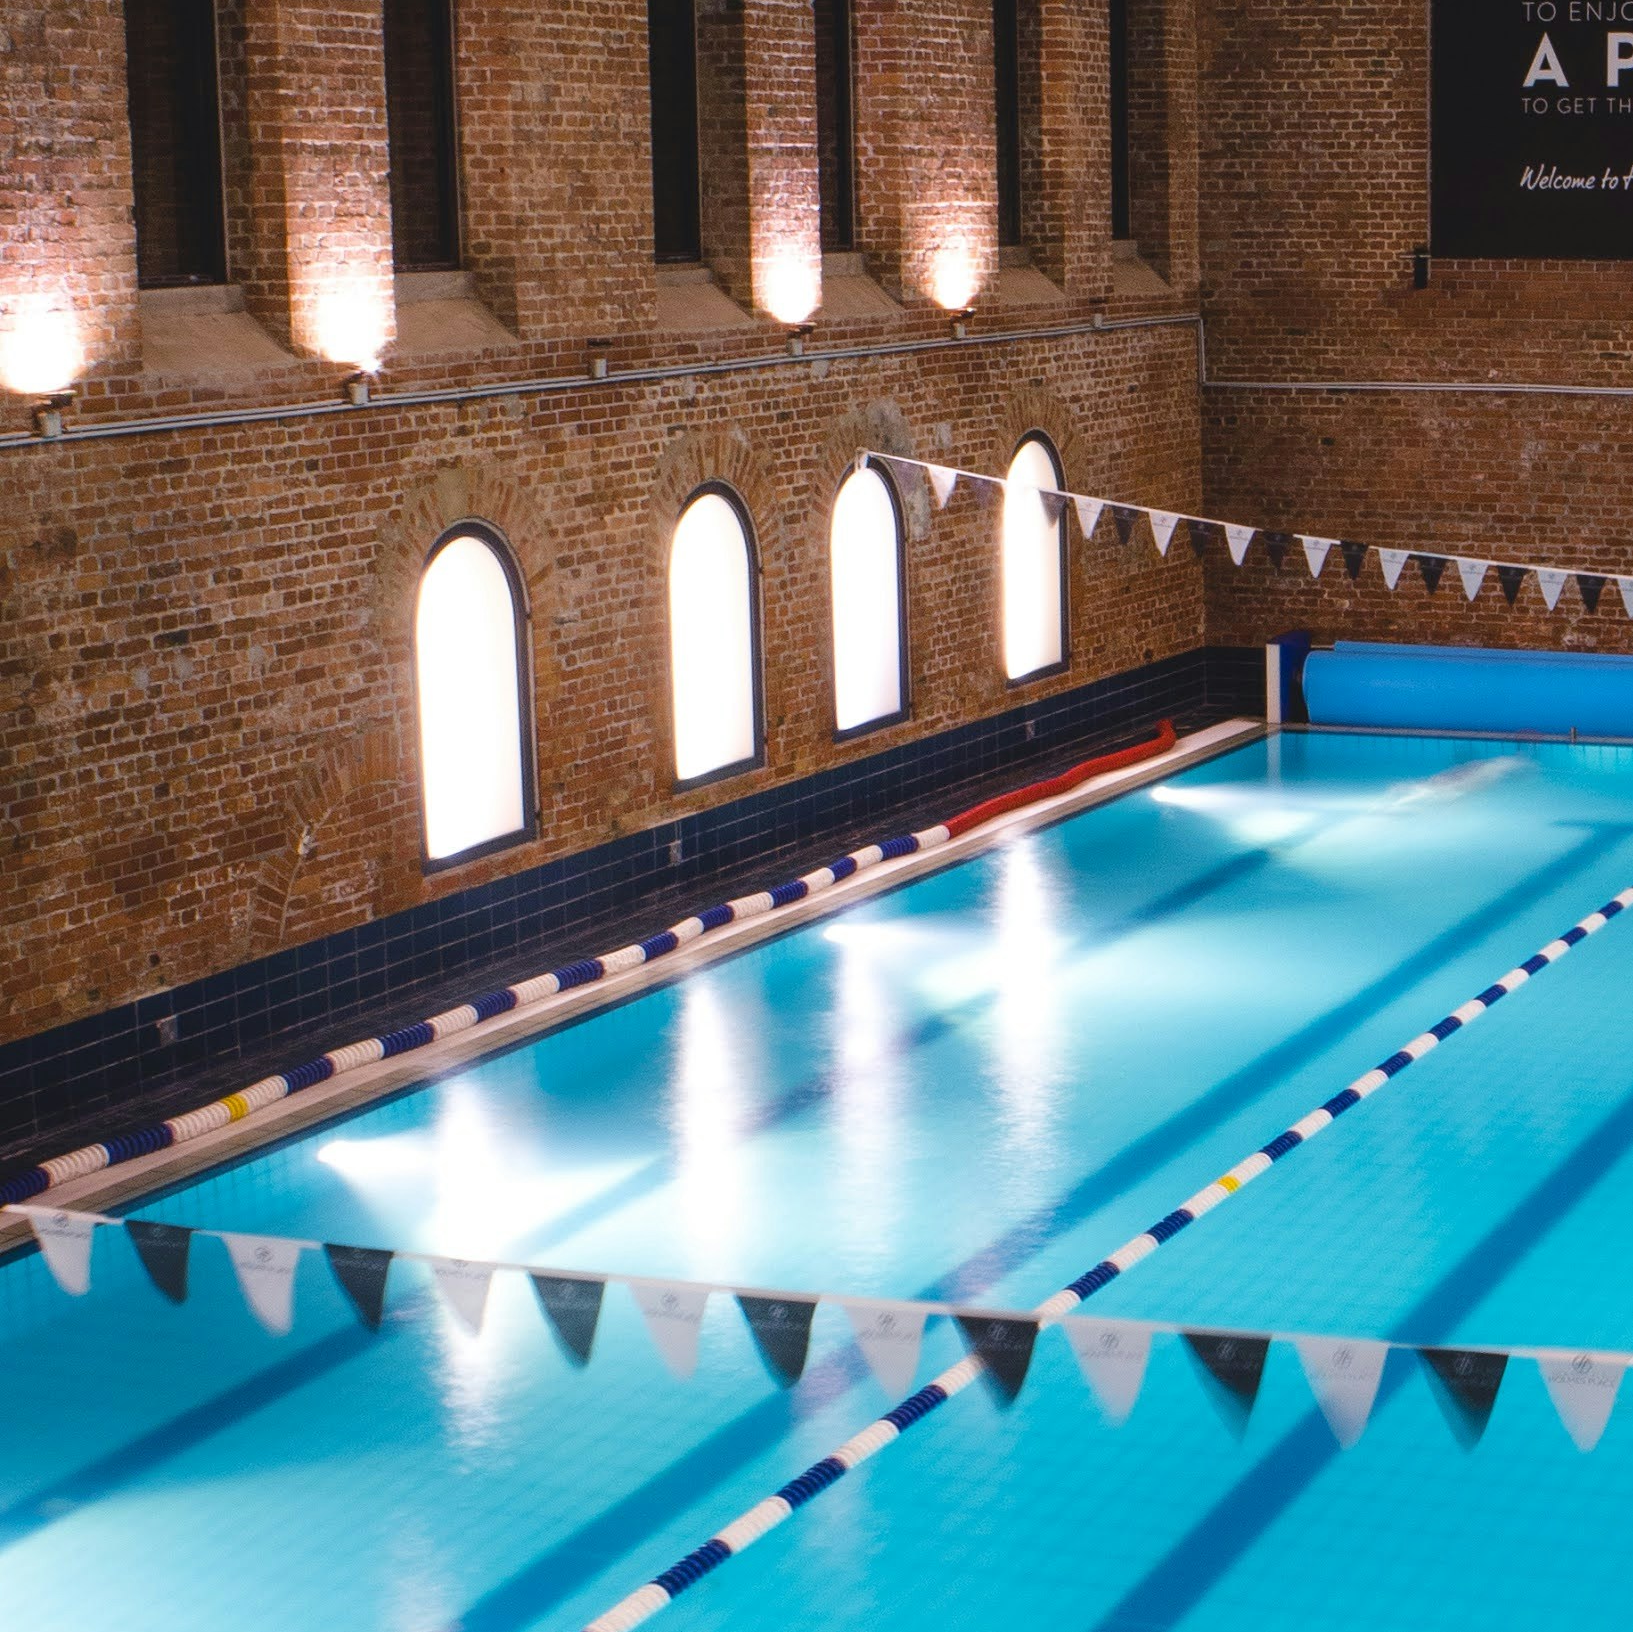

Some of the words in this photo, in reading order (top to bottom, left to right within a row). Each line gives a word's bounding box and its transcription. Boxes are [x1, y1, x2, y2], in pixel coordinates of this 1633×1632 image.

[1522, 1, 1557, 22] TO
[1522, 31, 1570, 88] A
[1521, 97, 1549, 115] TO
[1556, 97, 1597, 115] GET
[1519, 163, 1596, 191] Welcome
[1600, 167, 1619, 190] to
